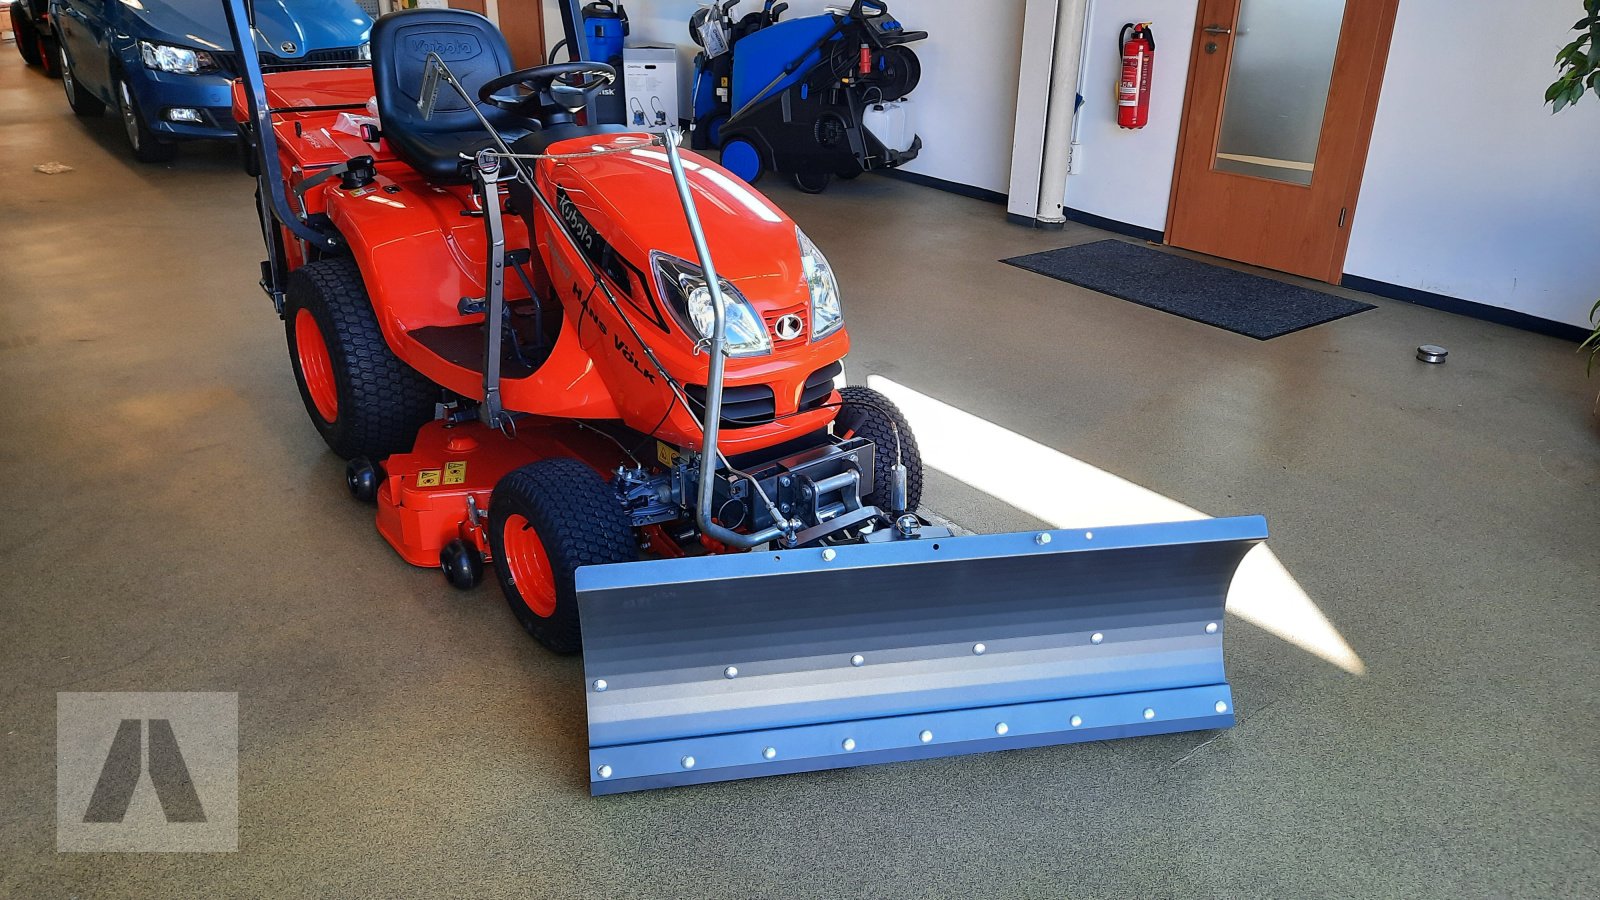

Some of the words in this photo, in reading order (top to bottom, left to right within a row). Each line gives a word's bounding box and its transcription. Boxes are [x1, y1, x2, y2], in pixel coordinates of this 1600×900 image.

[412, 40, 472, 55] Kubota
[599, 88, 616, 96] isk
[558, 194, 593, 249] Kubota
[572, 281, 608, 335] HANS
[614, 333, 656, 385] VÖLK
